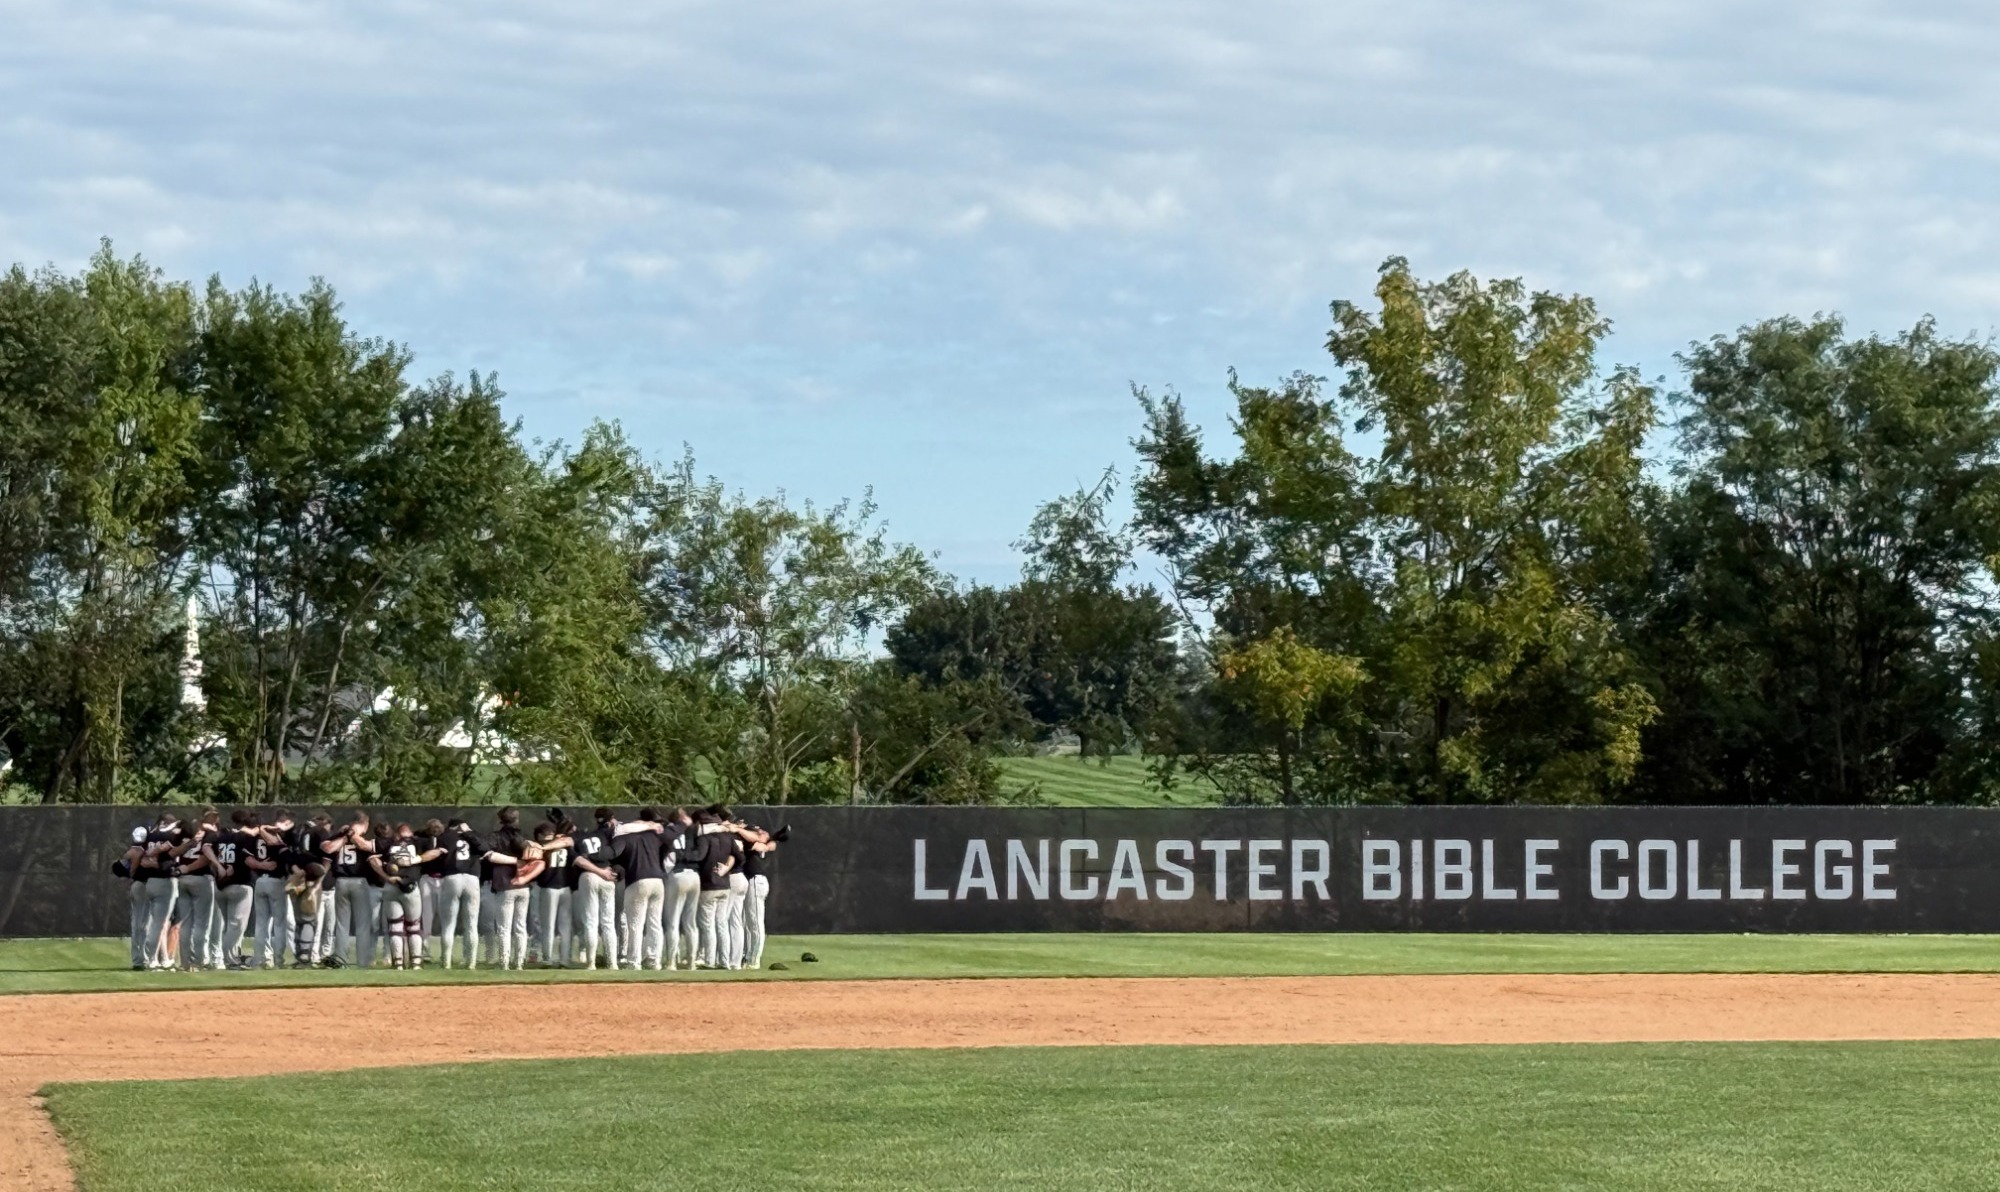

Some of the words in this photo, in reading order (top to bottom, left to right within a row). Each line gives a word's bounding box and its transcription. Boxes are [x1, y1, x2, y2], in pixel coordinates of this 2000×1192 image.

[218, 843, 236, 864] 36
[338, 844, 357, 865] 15
[456, 839, 470, 860] 3
[914, 839, 1331, 901] LANCASTER
[1362, 839, 1560, 901] BIBLE
[1590, 839, 1897, 901] COLLEGE
